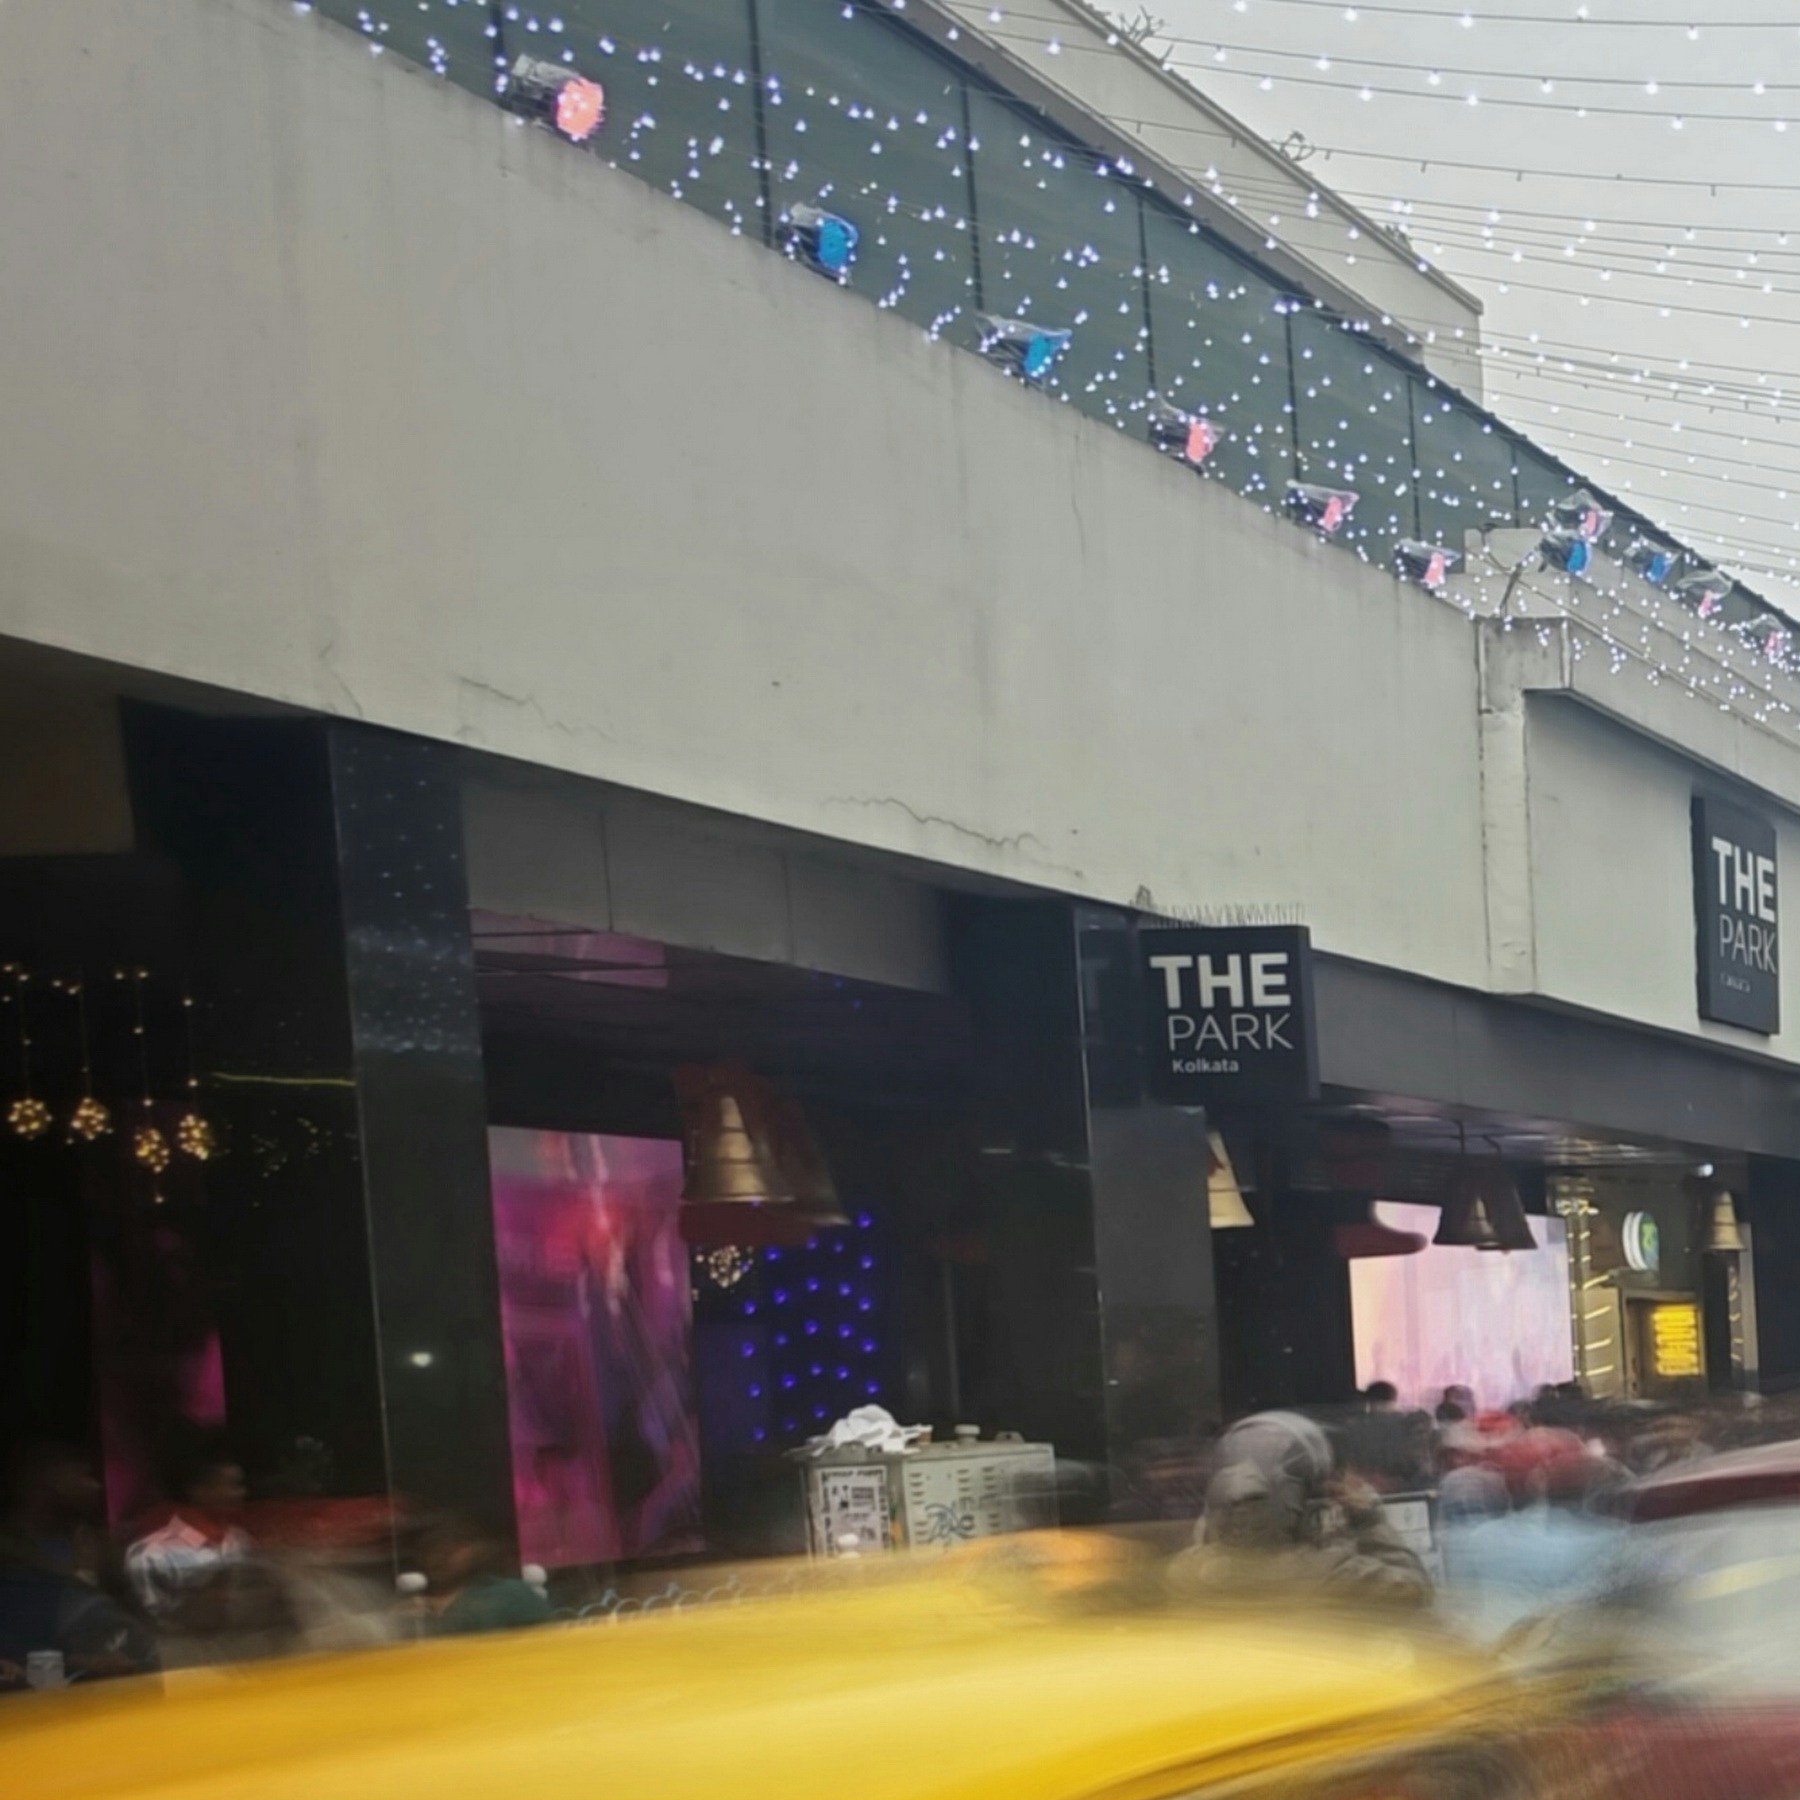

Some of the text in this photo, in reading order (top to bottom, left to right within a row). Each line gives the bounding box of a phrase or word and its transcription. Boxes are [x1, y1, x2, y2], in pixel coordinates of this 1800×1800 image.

[1711, 836, 1776, 923] THE
[1719, 914, 1777, 975] PARK
[1149, 952, 1292, 1009] THE
[1168, 1012, 1294, 1051] PARK
[1172, 1058, 1240, 1073] Kolkata
